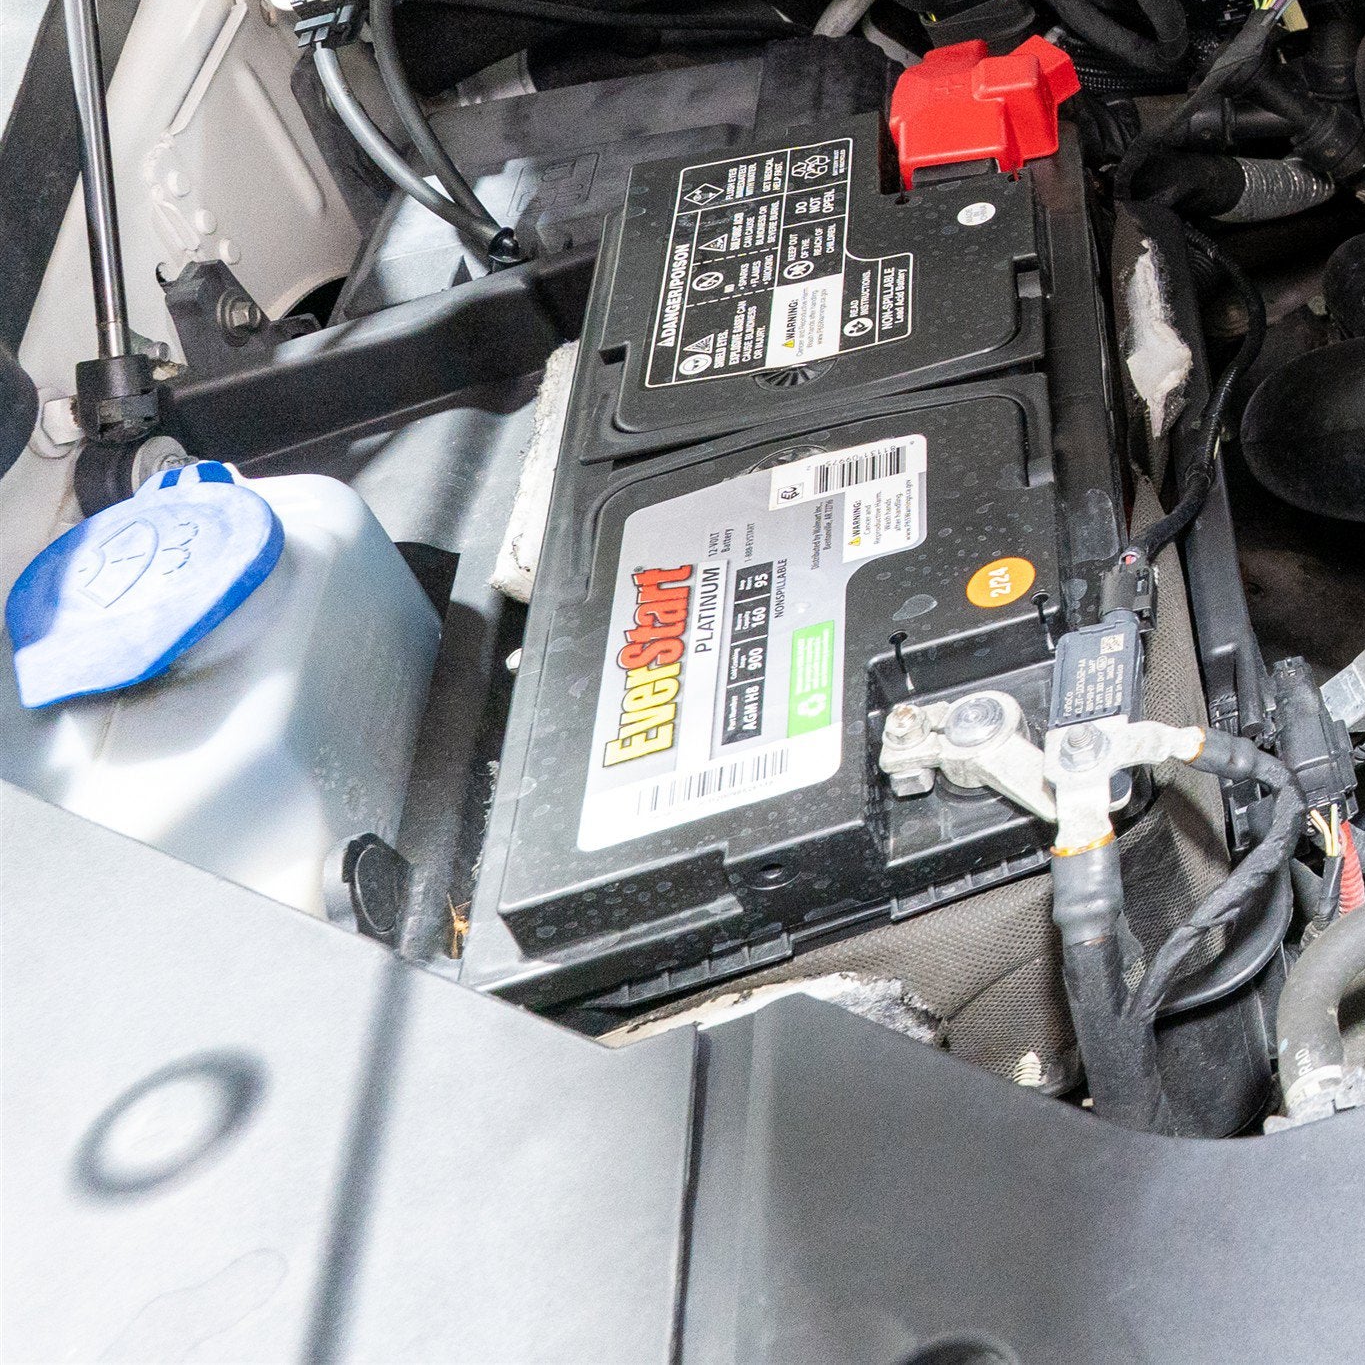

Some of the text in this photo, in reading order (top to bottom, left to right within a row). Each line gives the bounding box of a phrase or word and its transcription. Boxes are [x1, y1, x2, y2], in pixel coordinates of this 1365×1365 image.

[759, 205, 767, 214] OR
[795, 200, 807, 213] DO
[808, 195, 821, 213] NOT
[822, 188, 835, 213] OPEN.
[743, 216, 755, 248] CAN CAUSE
[813, 227, 823, 255] REACH OF
[787, 232, 798, 261] KEEP OUT
[800, 238, 809, 258] OF THE
[661, 243, 690, 338] DANGER/POISON
[881, 267, 894, 330] NON-SPILLABLE
[894, 267, 907, 323] Lead Acid Battery
[736, 300, 746, 314] CAN
[784, 298, 798, 340] WARNING:
[849, 299, 859, 317] READ
[741, 340, 753, 362] CAUSE
[753, 348, 763, 359] OR
[853, 500, 861, 536] WARNING:
[708, 532, 720, 557] 12-VOLT
[721, 528, 734, 554] Battery
[754, 573, 769, 588] 95
[774, 558, 788, 618] NONSPILLABLE
[989, 566, 1012, 598] 2/24
[694, 567, 720, 653] PLATINUM
[752, 606, 766, 627] 160
[603, 564, 693, 768] EverStart
[747, 647, 762, 670] 900
[742, 685, 759, 731] AGM H8
